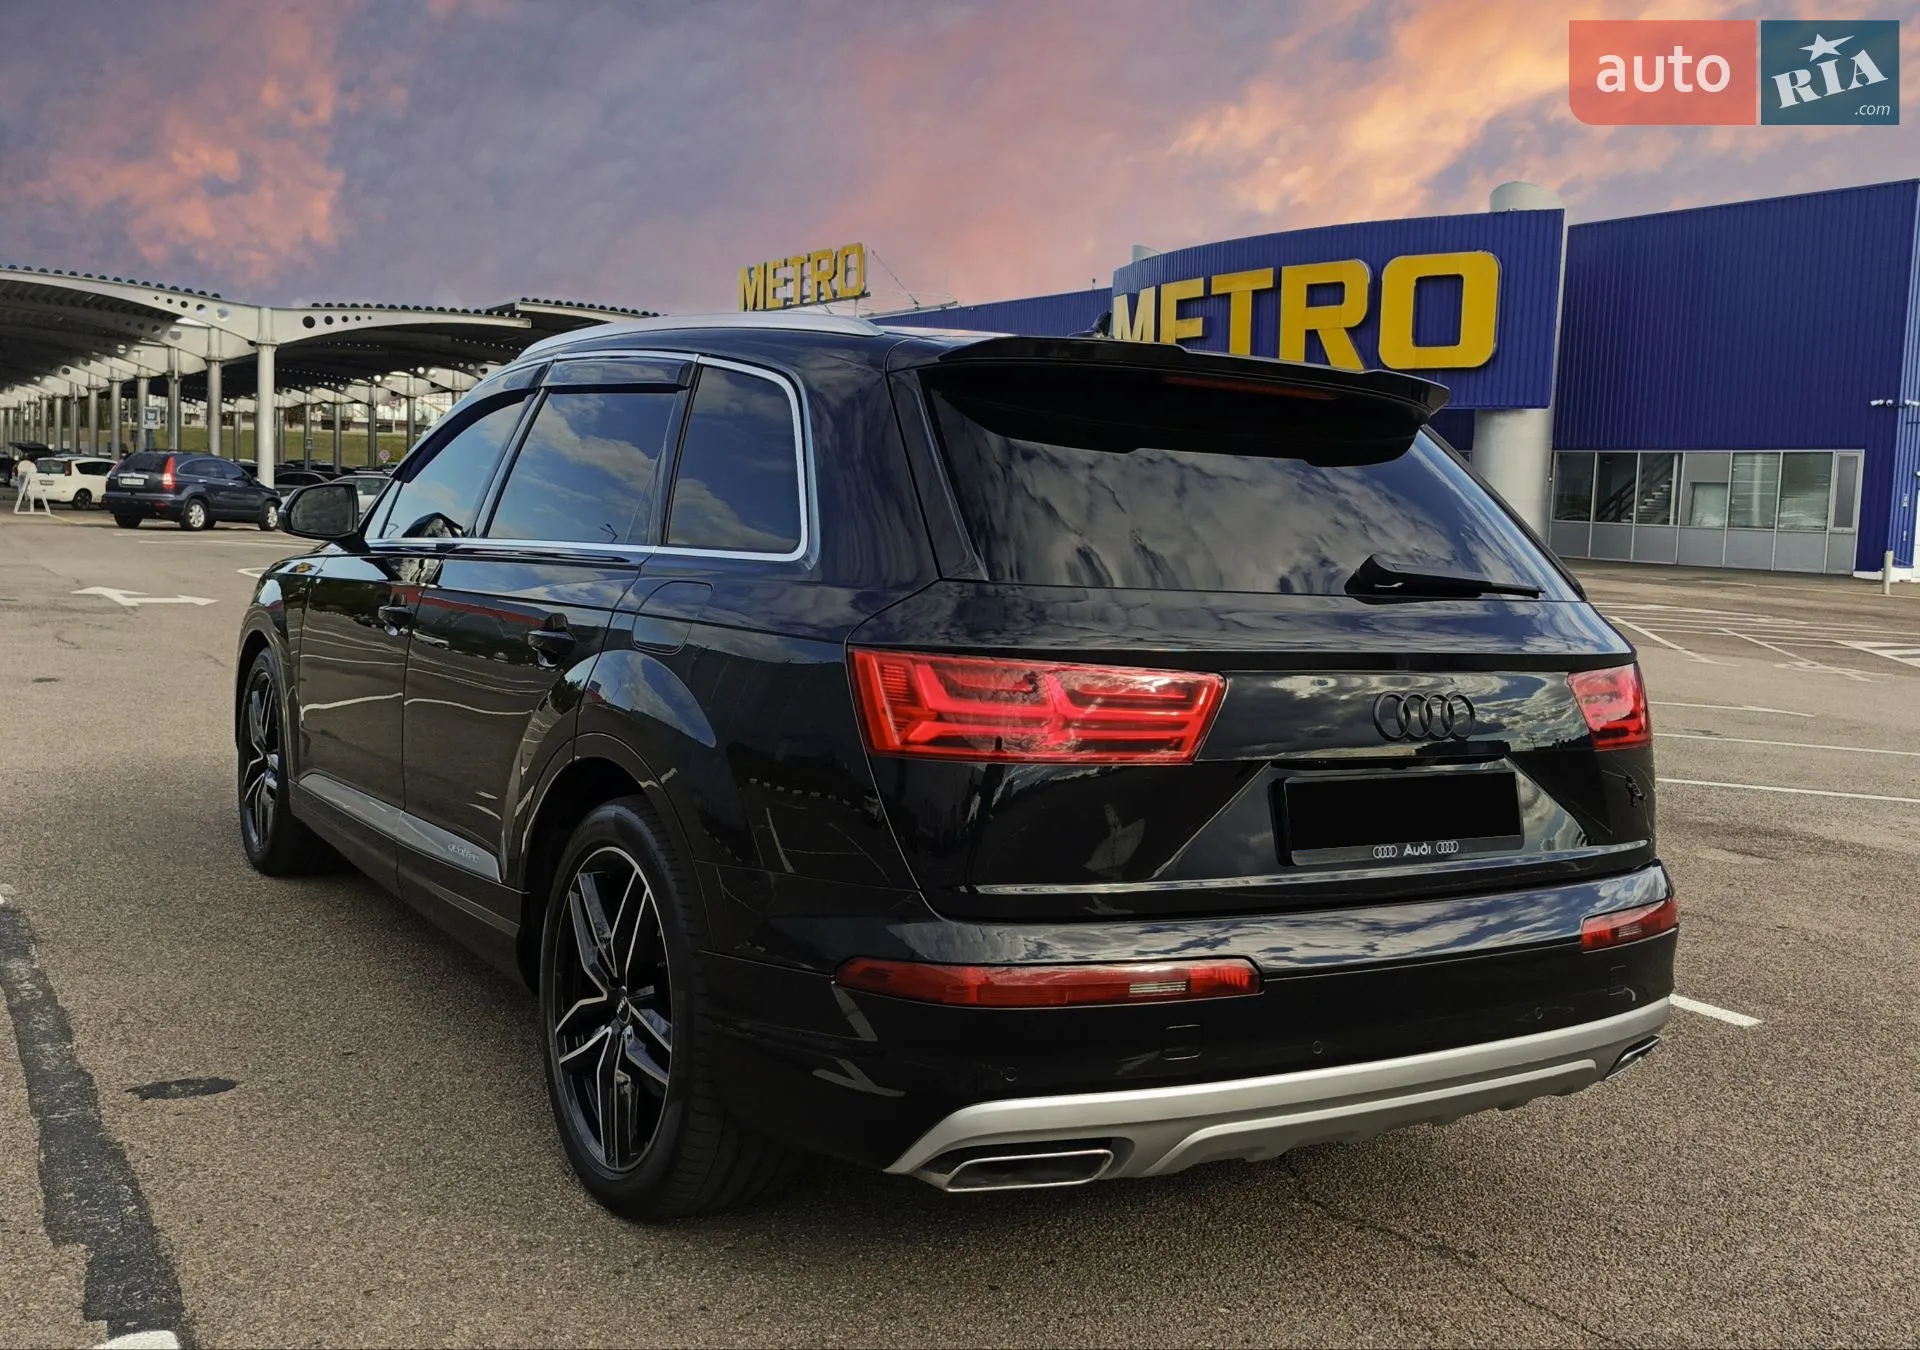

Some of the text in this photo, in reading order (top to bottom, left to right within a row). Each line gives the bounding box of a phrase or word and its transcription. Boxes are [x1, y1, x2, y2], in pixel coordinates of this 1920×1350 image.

[738, 242, 864, 312] METRO
[1113, 250, 1500, 373] METRO
[1403, 842, 1431, 856] Audi
